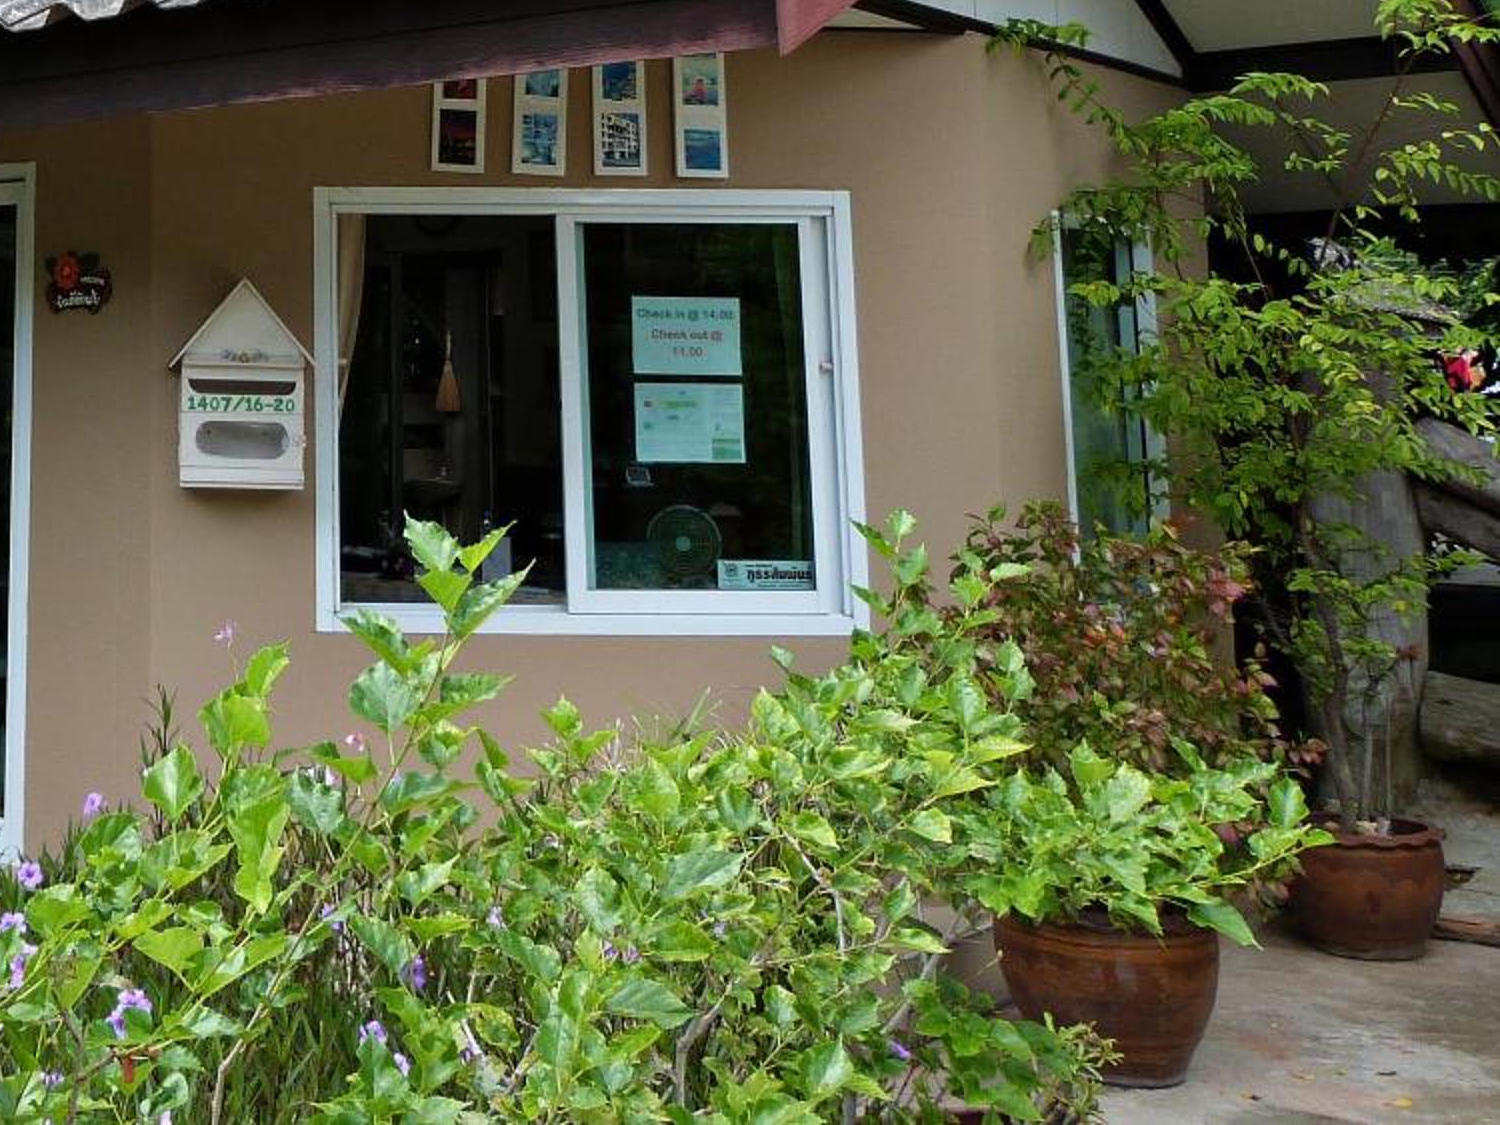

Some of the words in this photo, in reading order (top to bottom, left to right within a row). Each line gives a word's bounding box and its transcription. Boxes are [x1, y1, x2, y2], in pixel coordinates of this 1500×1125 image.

[637, 308, 671, 319] Check
[651, 328, 687, 340] Check
[690, 329, 708, 340] out
[187, 396, 295, 412] 1407/16-20
